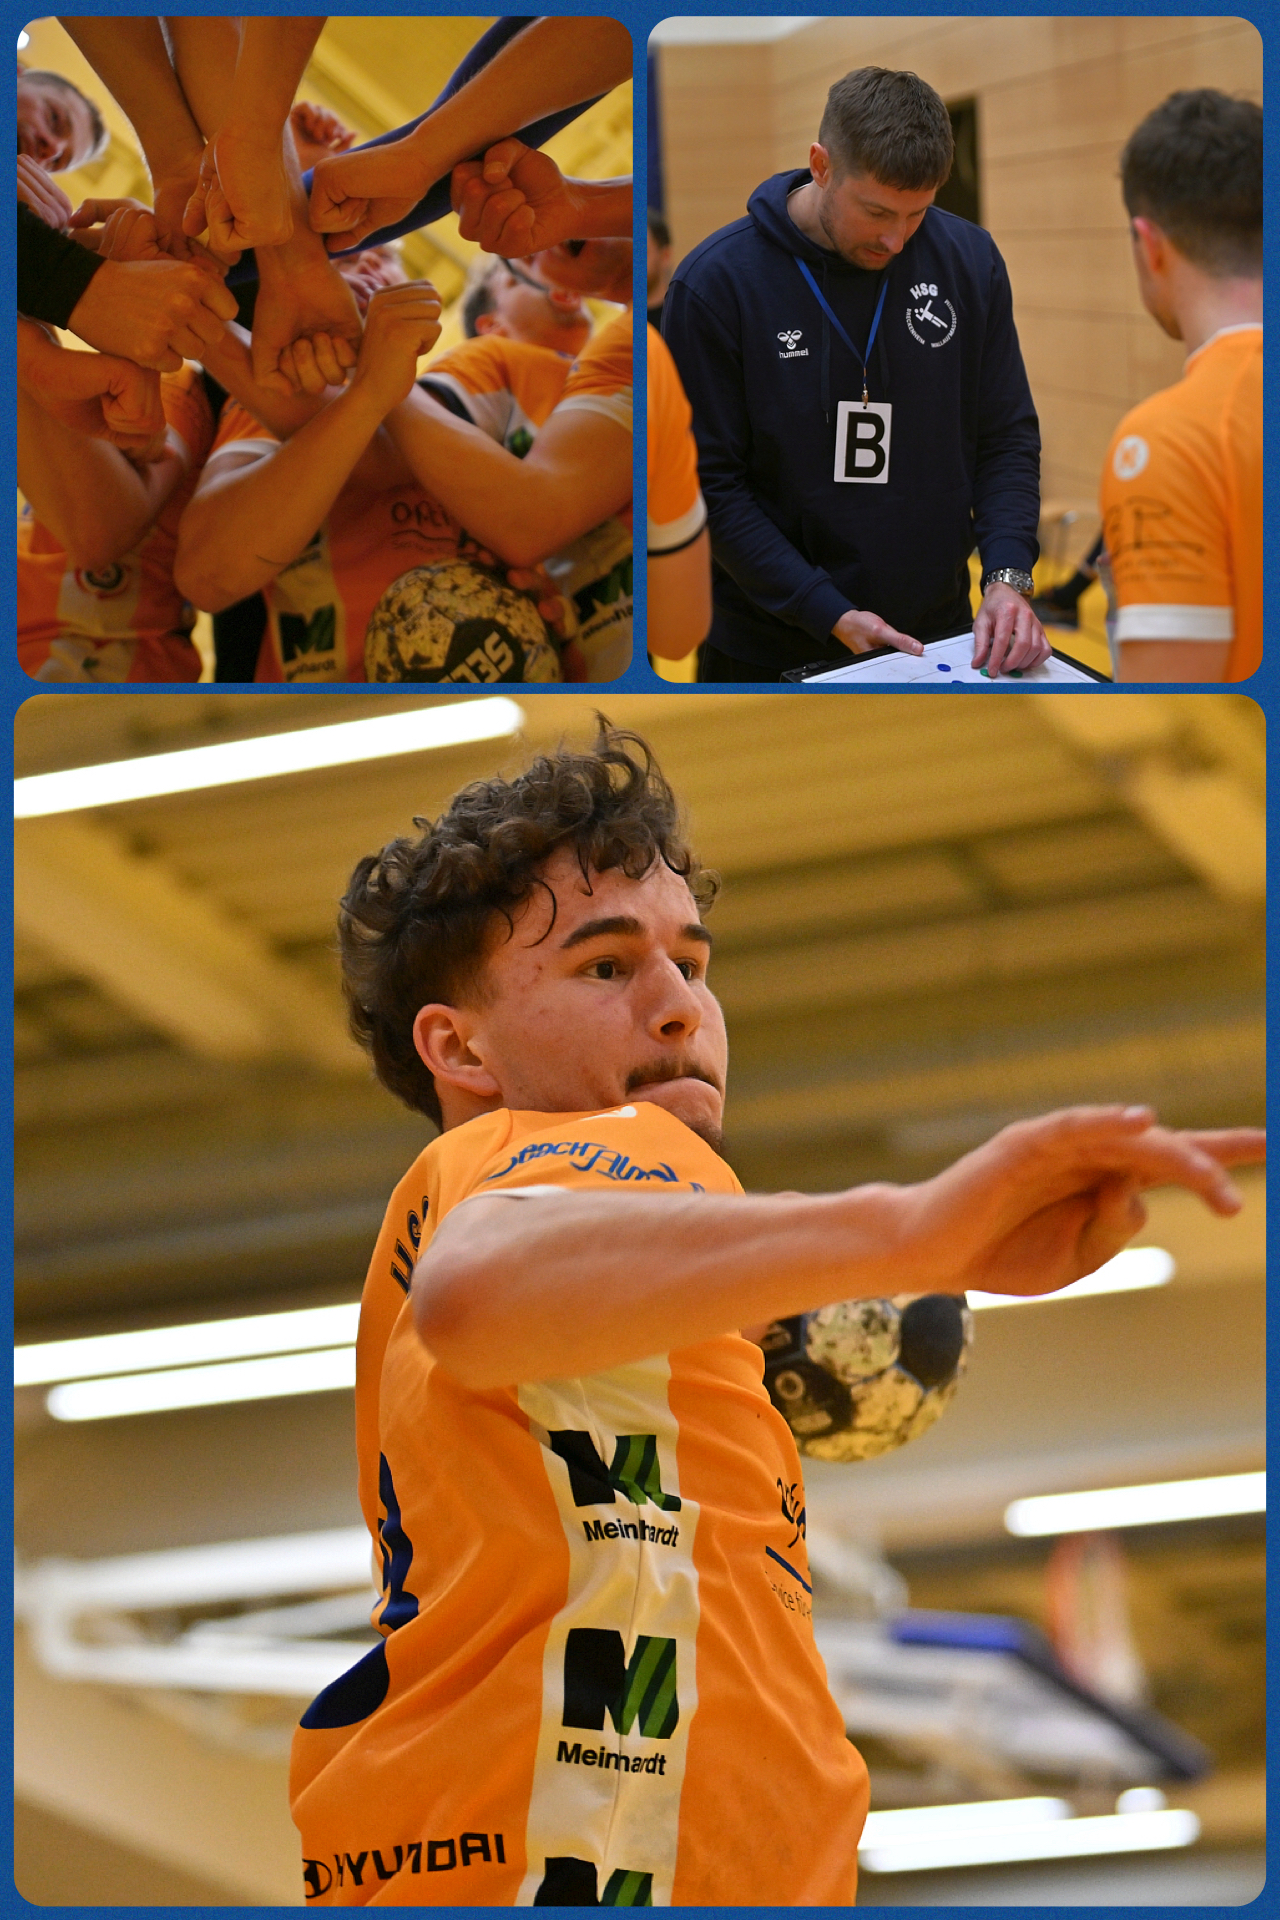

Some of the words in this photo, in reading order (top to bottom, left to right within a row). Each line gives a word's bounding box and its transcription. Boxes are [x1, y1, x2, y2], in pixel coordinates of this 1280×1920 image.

[909, 282, 939, 300] HSG
[778, 348, 810, 359] hummel
[844, 411, 886, 478] B
[583, 1518, 680, 1548] Meinhardt
